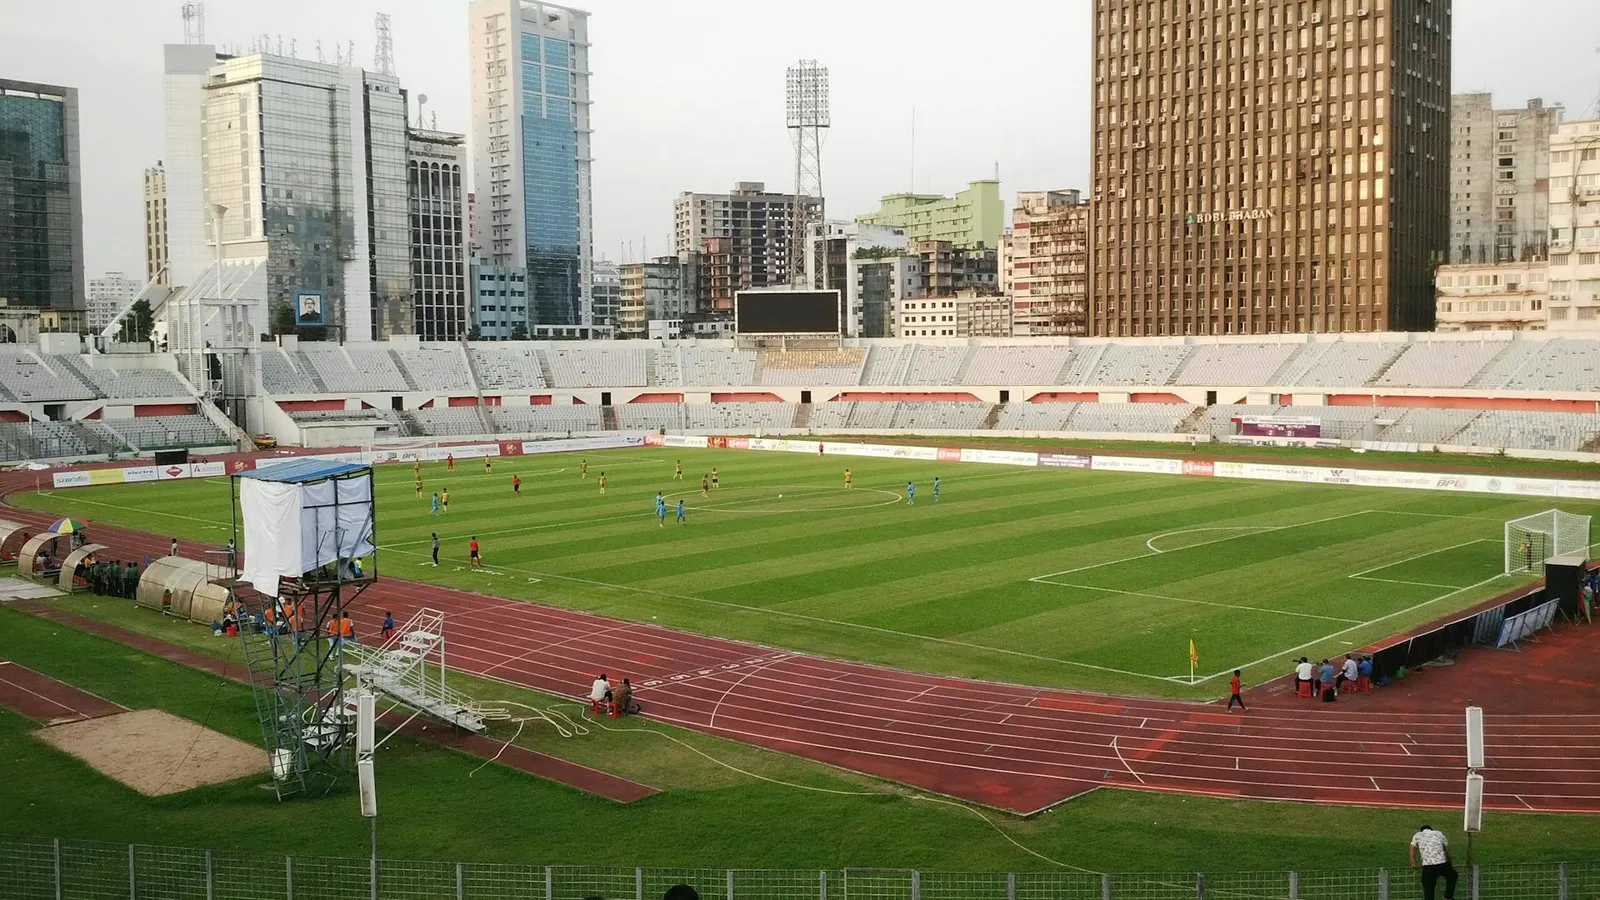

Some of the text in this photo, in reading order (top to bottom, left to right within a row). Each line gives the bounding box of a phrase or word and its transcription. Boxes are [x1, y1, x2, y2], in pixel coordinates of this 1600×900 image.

[1196, 208, 1274, 224] BDBL BHABAN
[1323, 476, 1350, 484] WALTON
